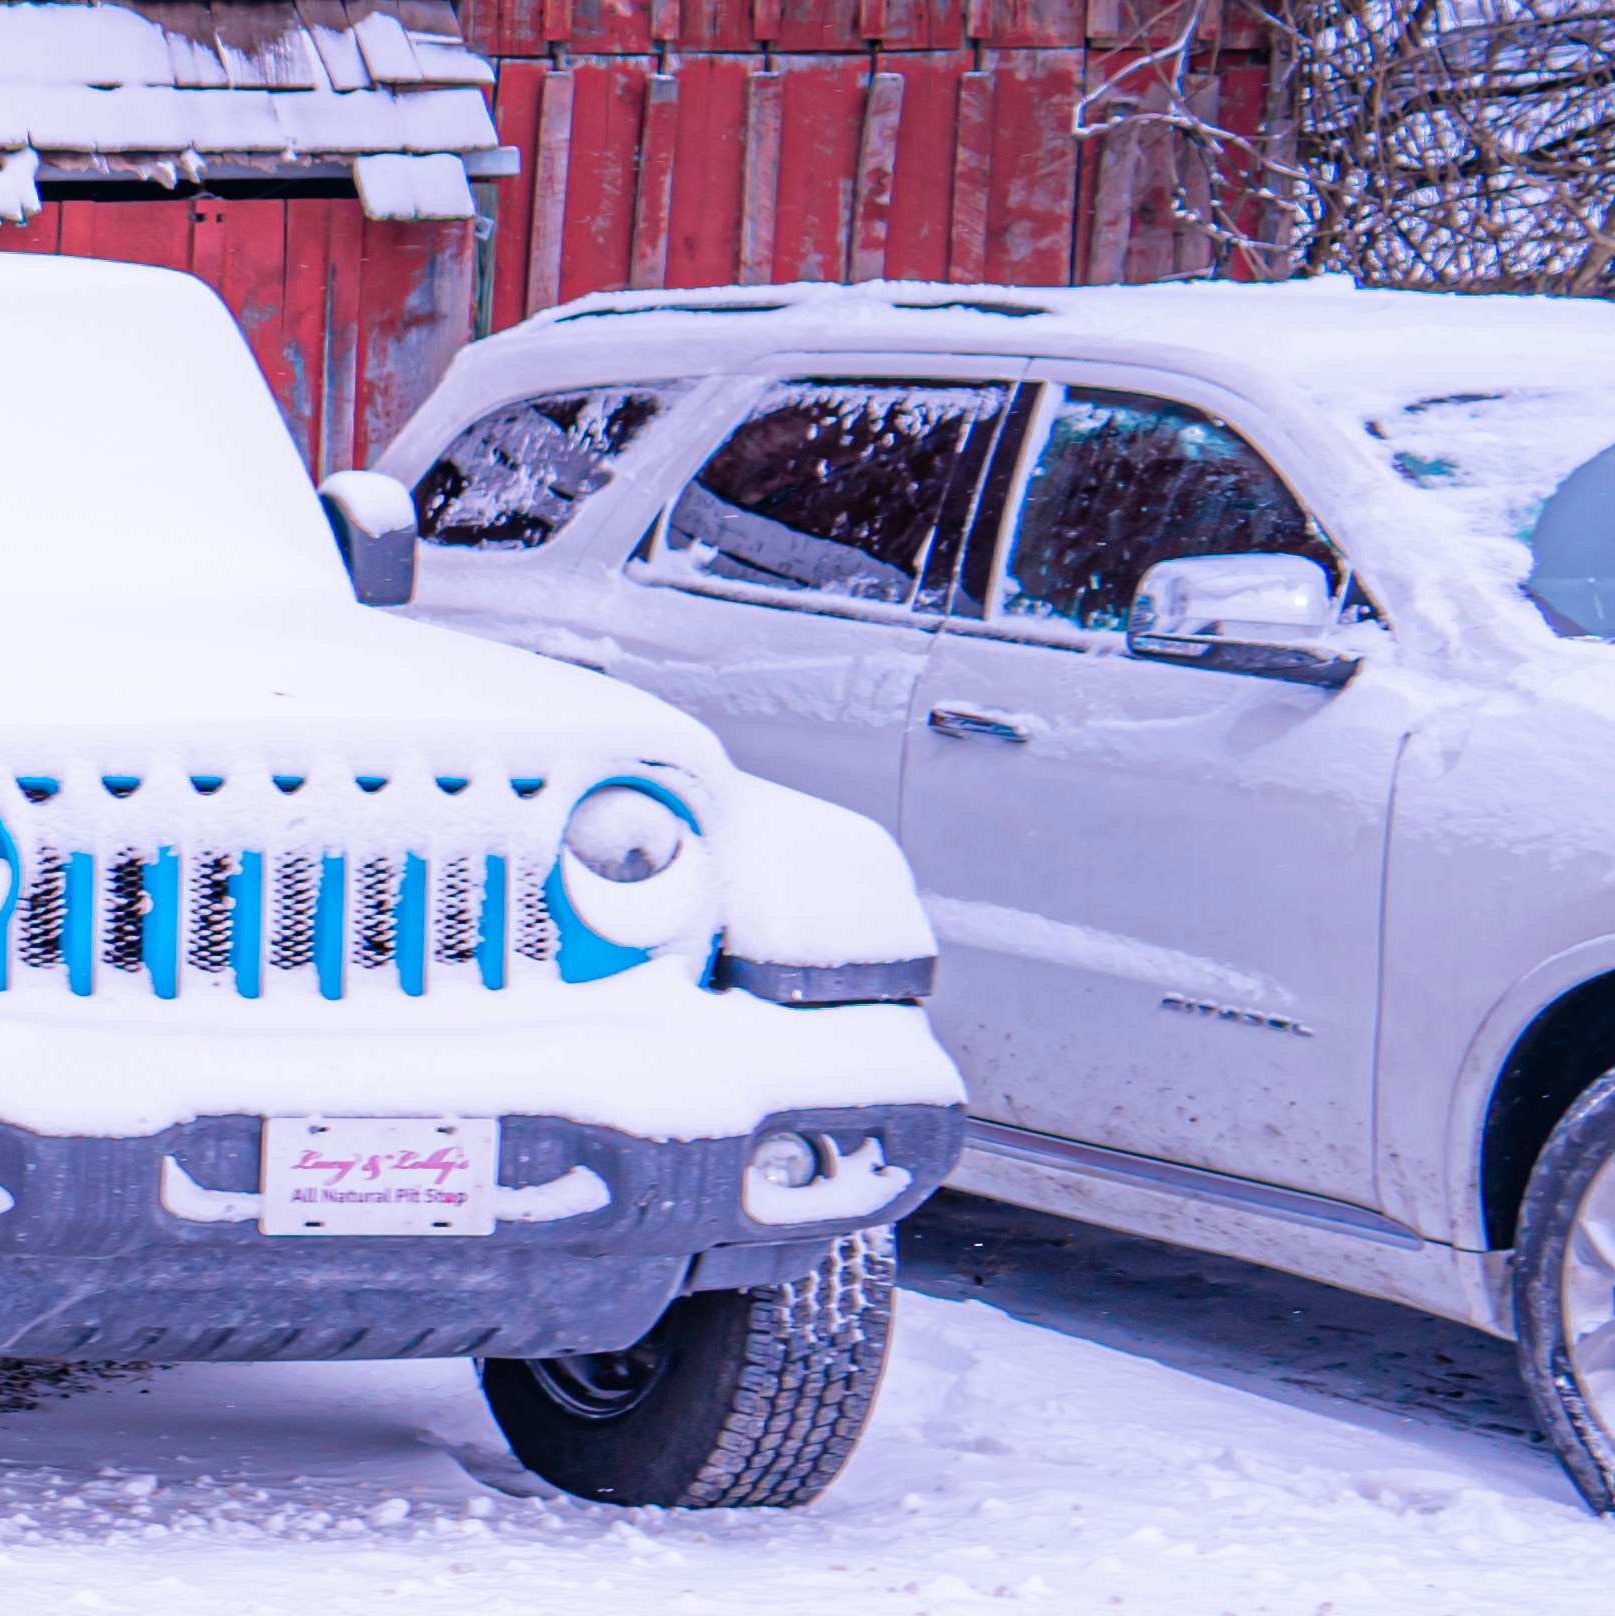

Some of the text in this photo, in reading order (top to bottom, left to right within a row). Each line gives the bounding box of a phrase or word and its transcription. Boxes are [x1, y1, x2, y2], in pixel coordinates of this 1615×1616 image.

[290, 1188, 469, 1206] All Natural Pit Stop
